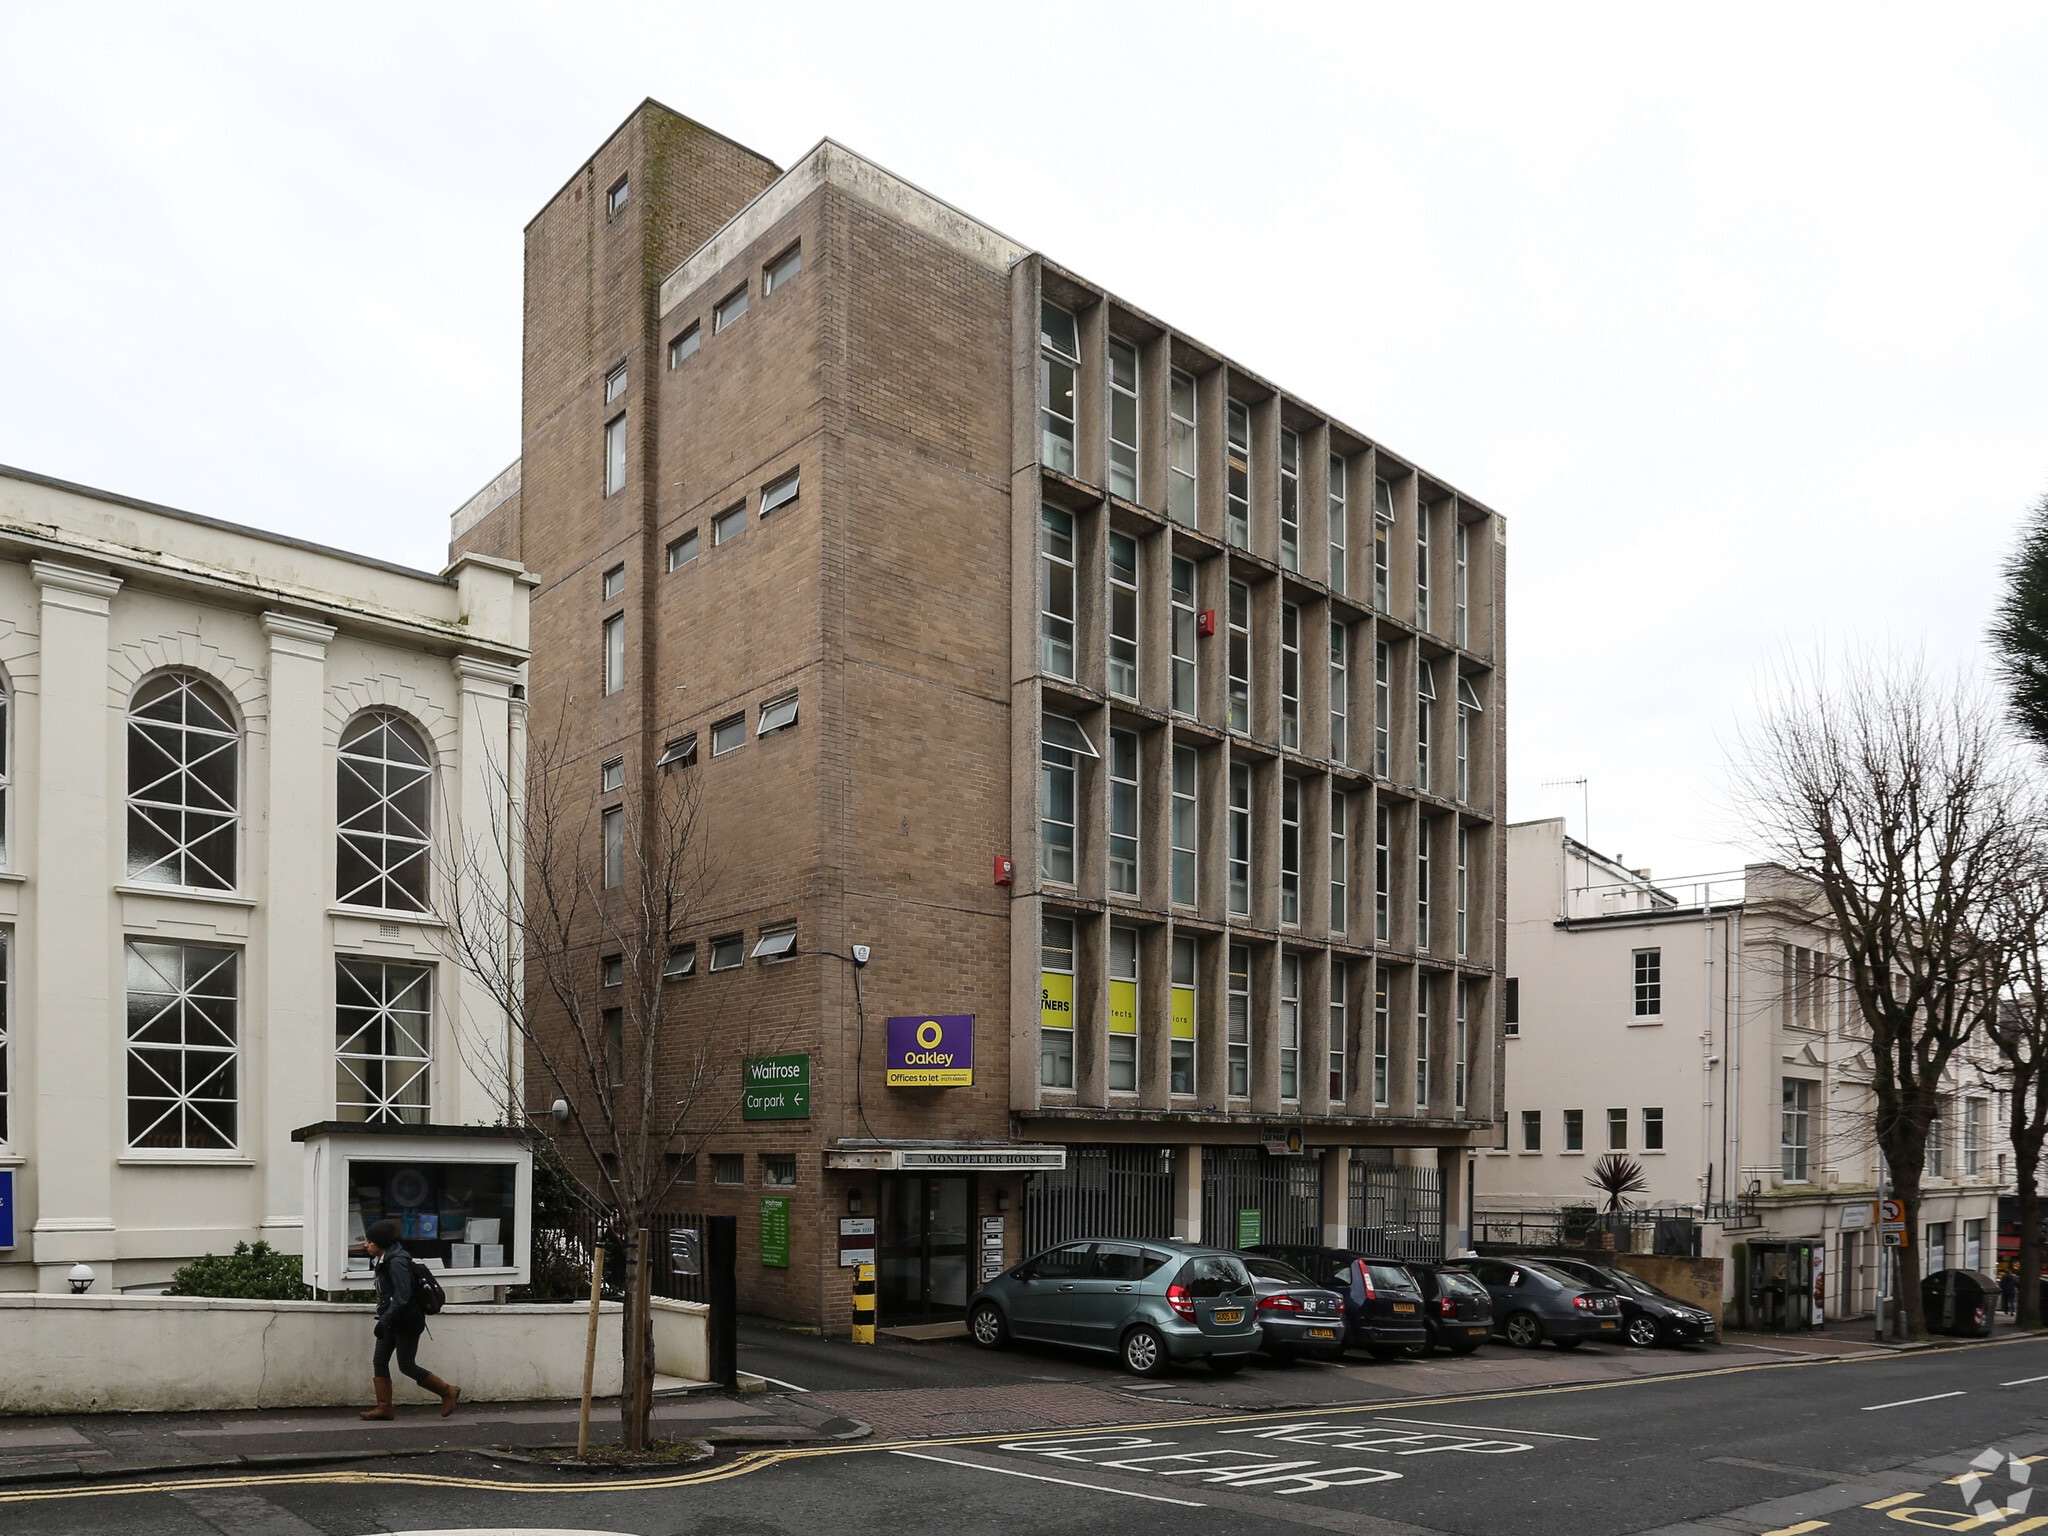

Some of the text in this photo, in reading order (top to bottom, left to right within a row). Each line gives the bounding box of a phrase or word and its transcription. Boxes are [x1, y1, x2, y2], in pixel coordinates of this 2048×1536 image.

[1111, 1009, 1132, 1018] tects
[904, 1051, 954, 1067] Oakley
[751, 1061, 801, 1080] Waitrose
[890, 1073, 939, 1082] Offices to let
[747, 1092, 785, 1111] Car park
[927, 1154, 1042, 1164] MONTPELIER HOUSE
[1216, 1421, 1535, 1456] KEEP
[997, 1435, 1404, 1495] CLEAR
